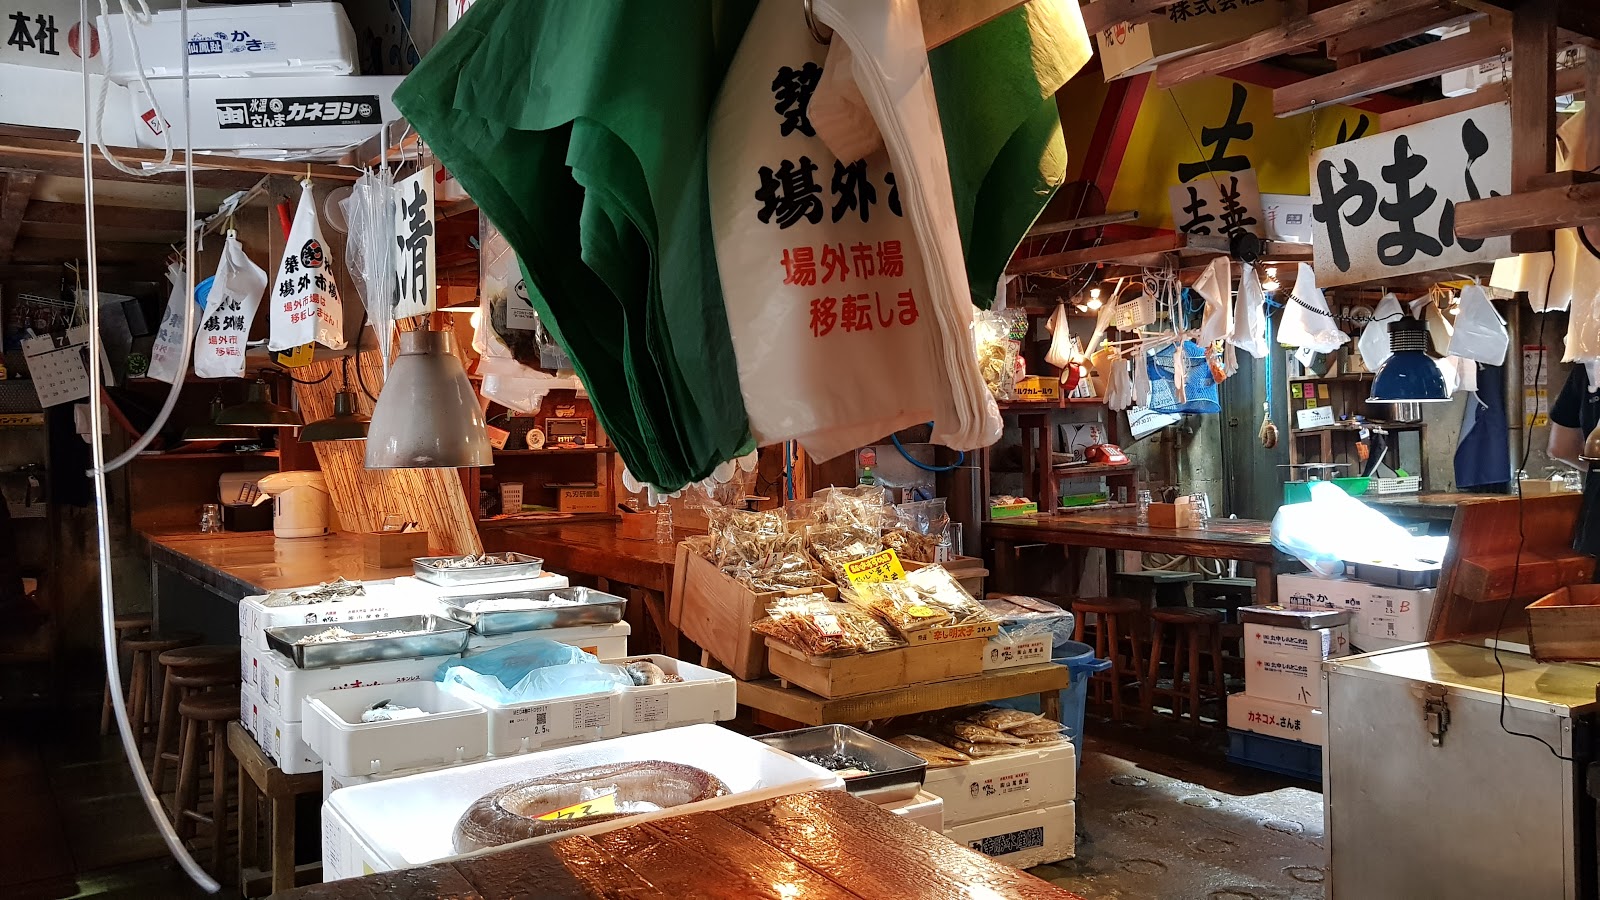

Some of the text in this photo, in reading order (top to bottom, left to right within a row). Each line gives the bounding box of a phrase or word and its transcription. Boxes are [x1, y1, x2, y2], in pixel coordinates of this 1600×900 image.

[8, 11, 60, 55] 本社
[250, 113, 286, 128] さんま
[286, 101, 359, 122] カネヨシ
[809, 288, 920, 338] 移転しま
